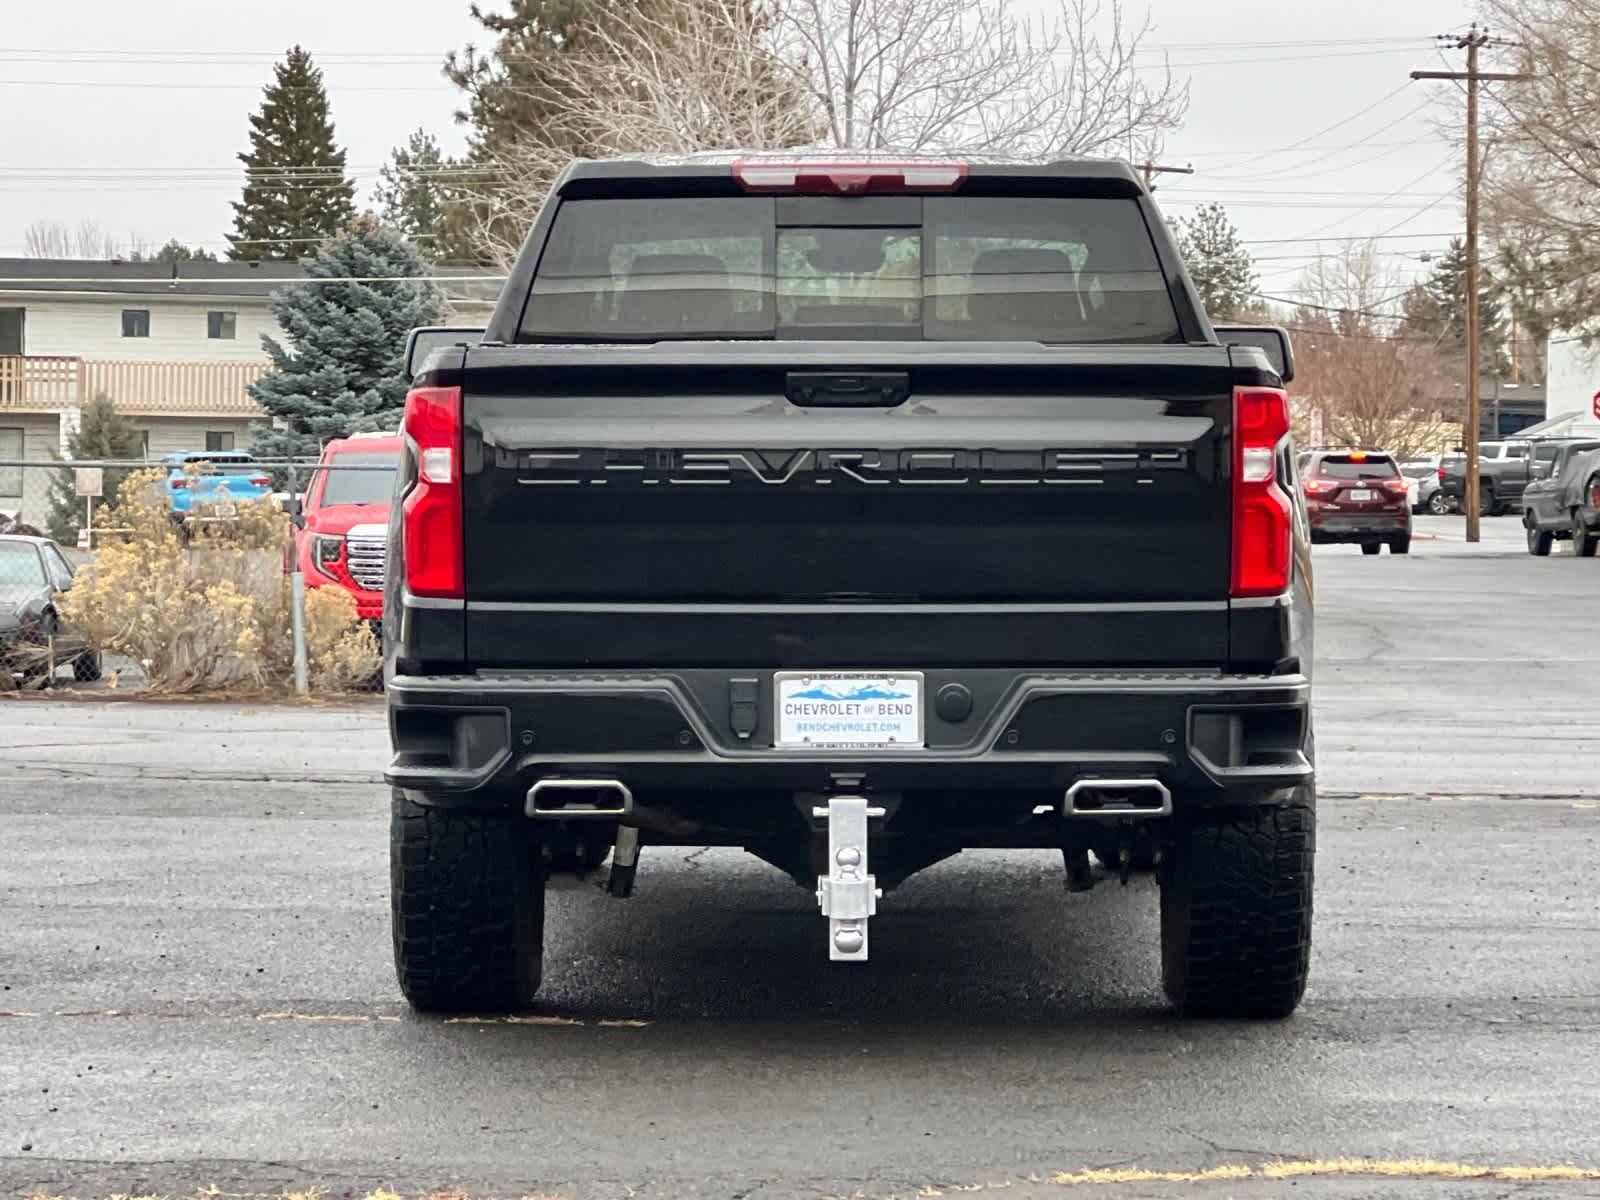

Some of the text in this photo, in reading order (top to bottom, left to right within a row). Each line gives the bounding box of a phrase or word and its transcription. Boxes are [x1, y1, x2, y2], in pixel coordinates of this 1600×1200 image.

[517, 448, 1188, 485] CHEVROLET
[785, 703, 862, 715] CHEVROLET
[878, 703, 913, 715] BEND
[796, 722, 901, 732] BENDCHEVROLET.COM
